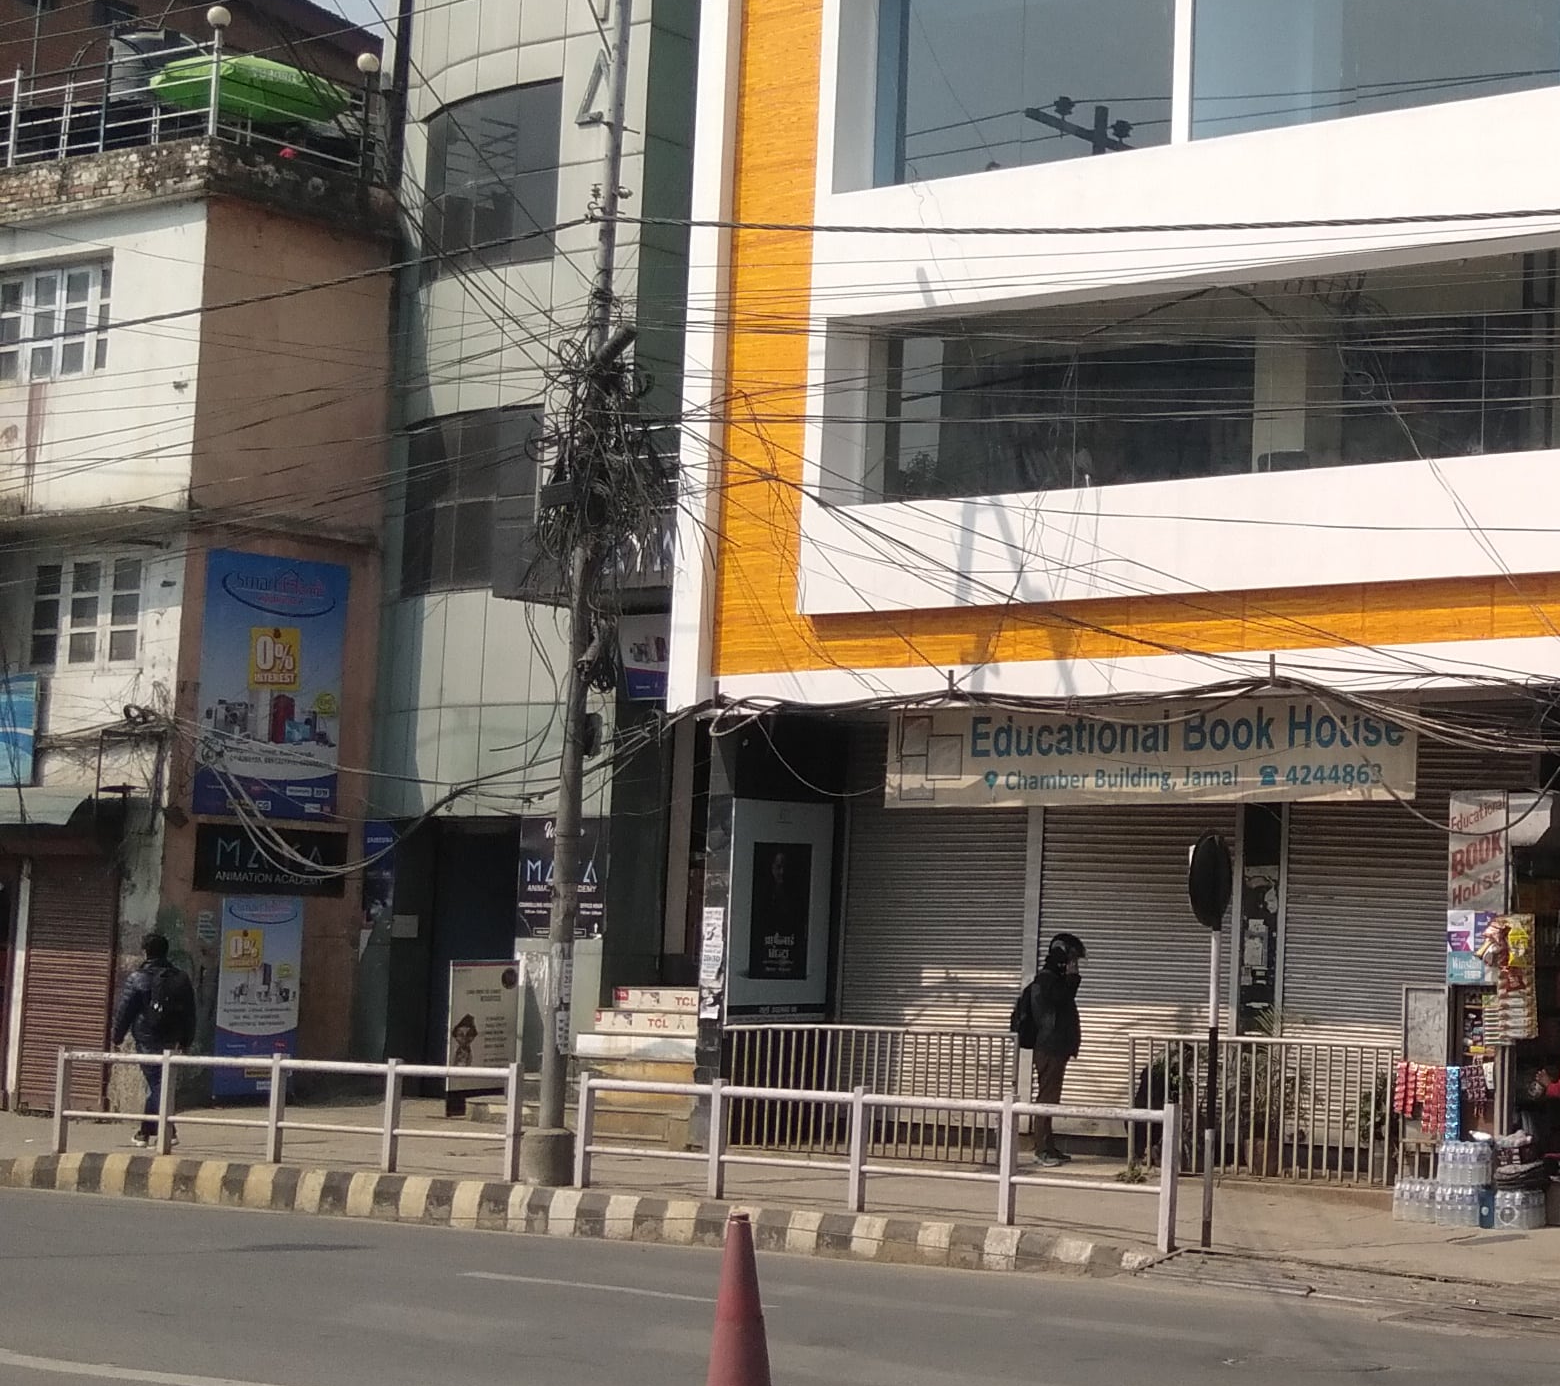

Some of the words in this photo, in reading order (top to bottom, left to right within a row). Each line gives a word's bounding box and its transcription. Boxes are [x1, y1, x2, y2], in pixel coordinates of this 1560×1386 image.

[256, 635, 294, 672] 0%
[970, 709, 1170, 758] Educational
[1183, 707, 1276, 751] Book
[1288, 705, 1405, 750] House
[1004, 770, 1086, 790] Chamber
[1094, 766, 1177, 792] Building,
[1183, 764, 1239, 787] Jamal
[1285, 763, 1384, 787] 4244863
[1450, 799, 1506, 831] Educational
[215, 837, 324, 871] MAA
[1451, 832, 1504, 879] BOOK
[215, 870, 273, 885] ANIMATION
[274, 874, 325, 887] ACADEMY
[526, 859, 599, 884] MAA
[1452, 870, 1503, 907] House
[675, 996, 697, 1007] TCL
[647, 1018, 669, 1029] TCL
